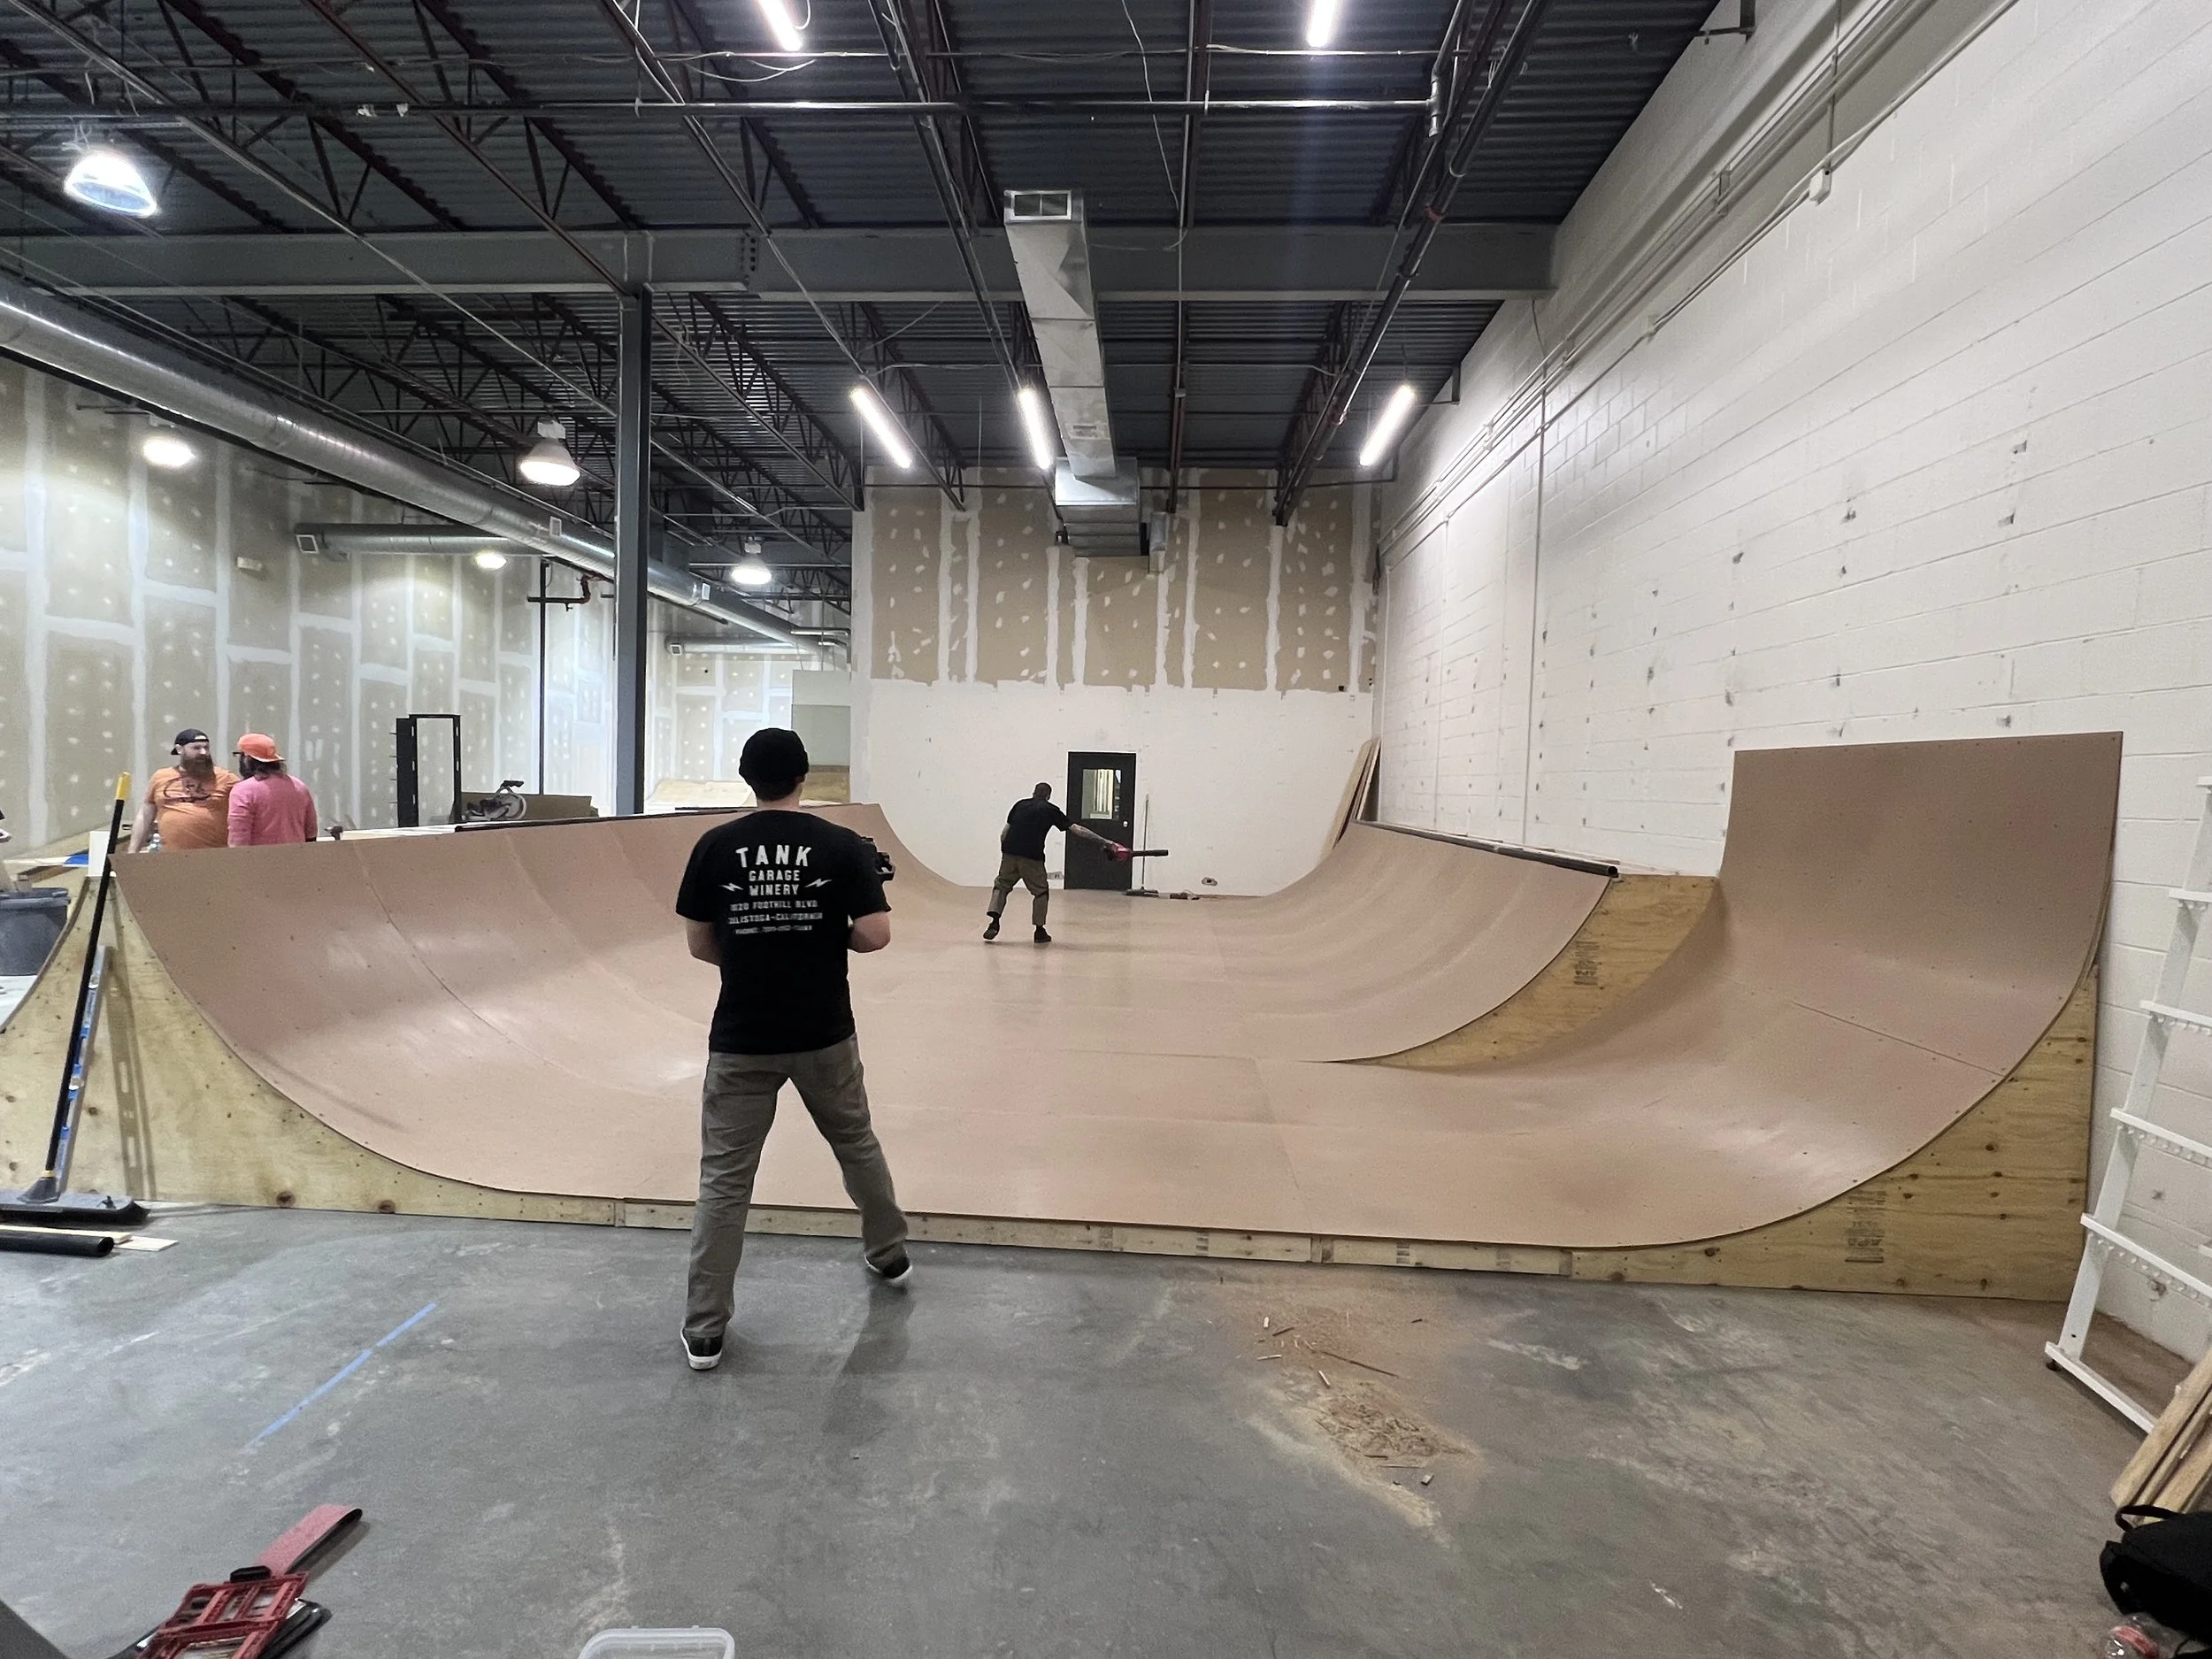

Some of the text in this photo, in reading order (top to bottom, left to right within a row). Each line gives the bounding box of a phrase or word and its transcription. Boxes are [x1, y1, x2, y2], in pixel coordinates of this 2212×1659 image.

[734, 844, 812, 868] TANK
[749, 870, 801, 881] GARAGE
[749, 884, 800, 896] WINERY
